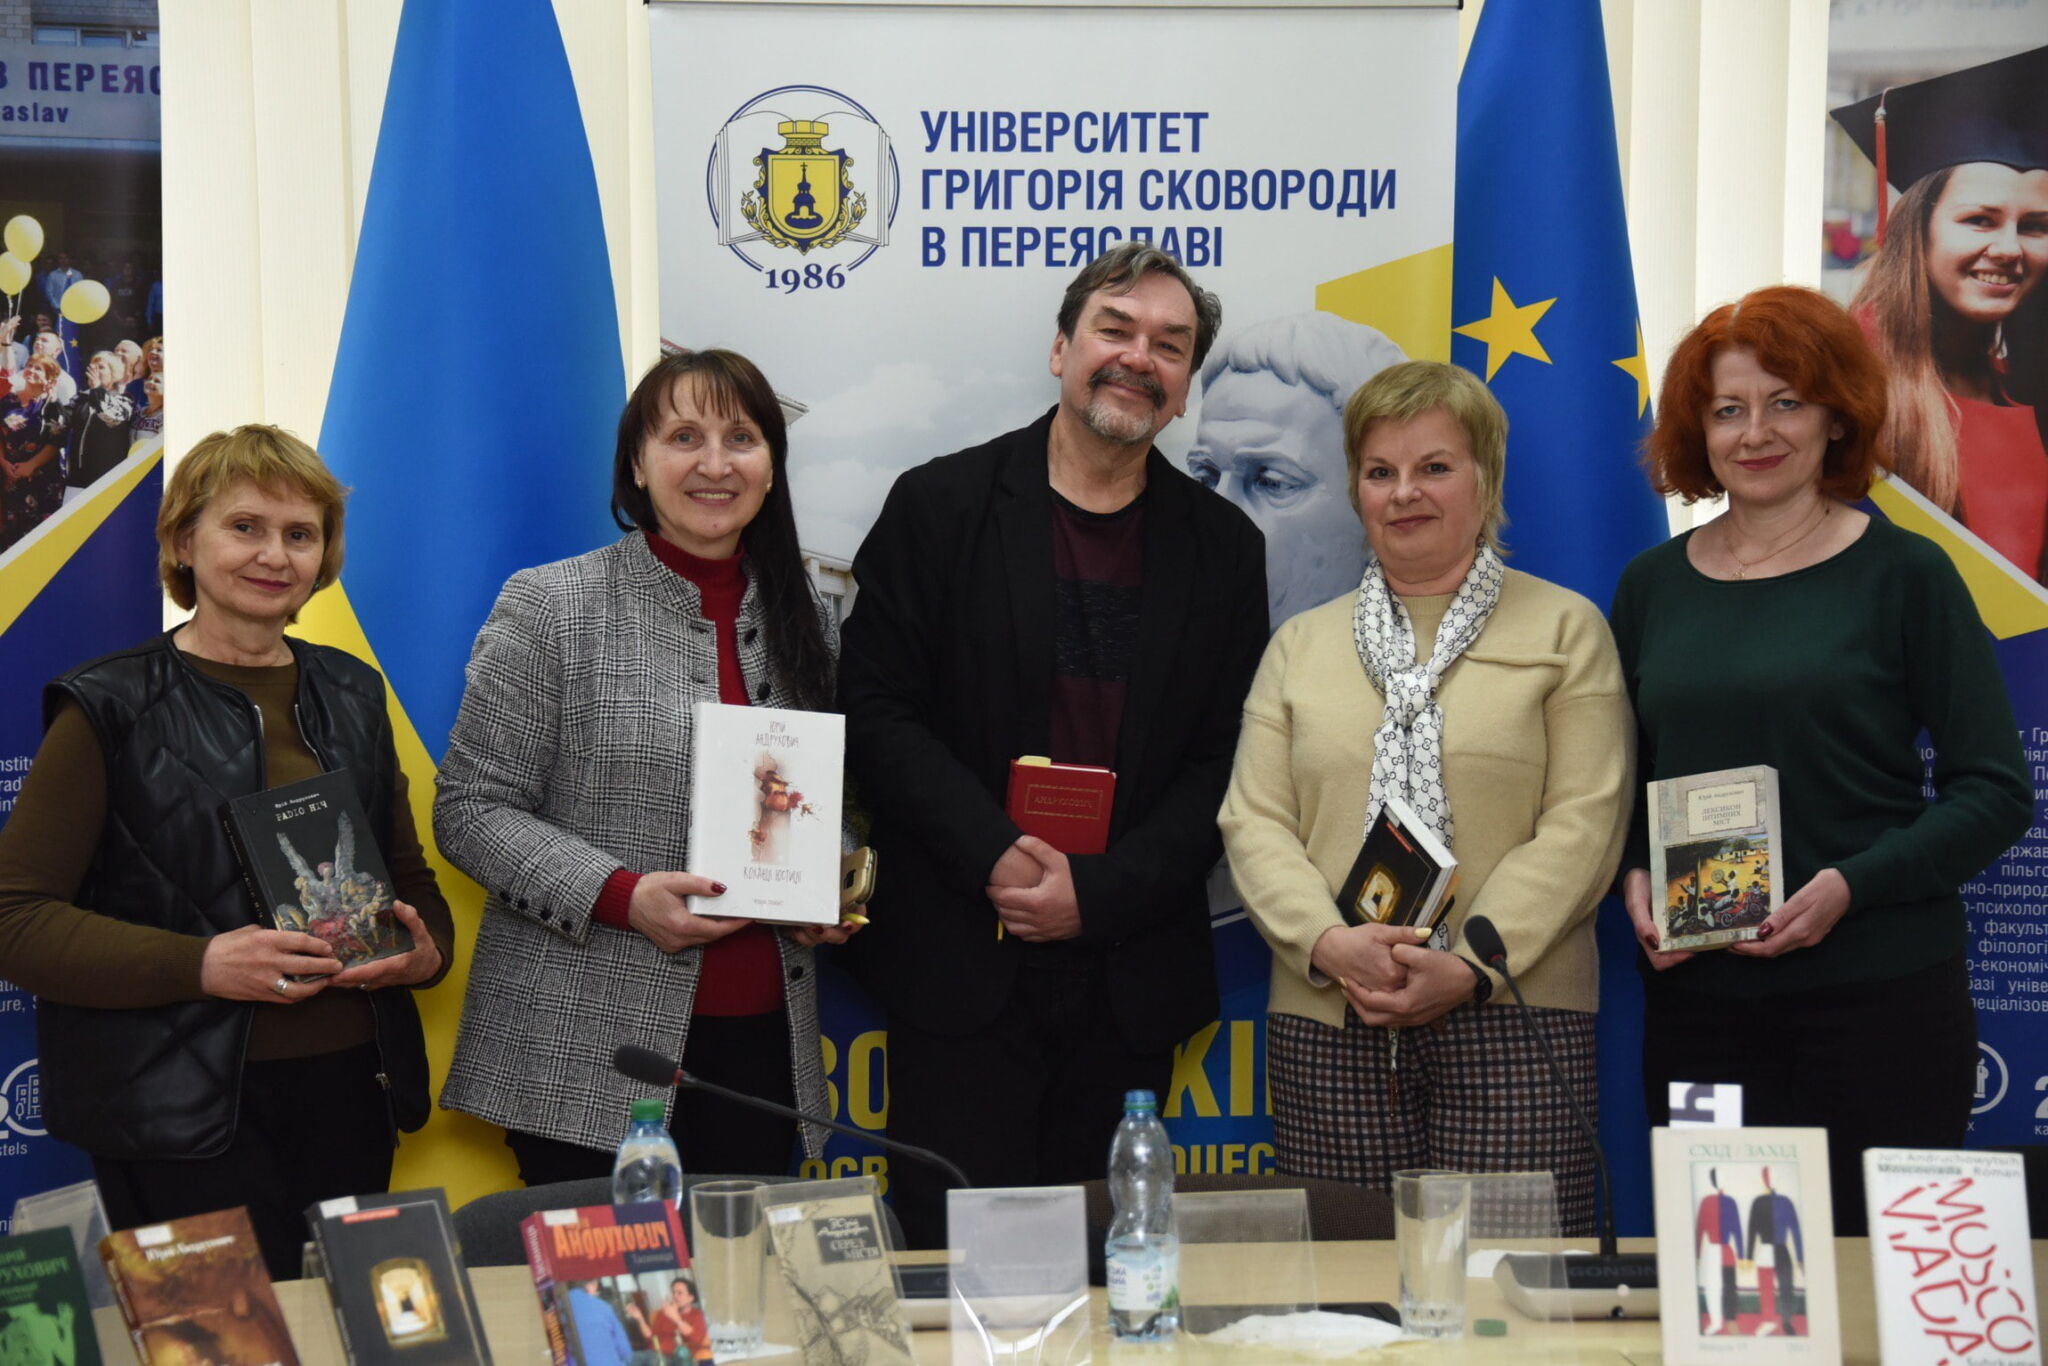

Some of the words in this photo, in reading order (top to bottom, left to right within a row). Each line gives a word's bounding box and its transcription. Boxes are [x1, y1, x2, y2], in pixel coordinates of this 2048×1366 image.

[920, 111, 1208, 154] УНІВЕРСИТЕТ
[920, 169, 1123, 211] ГРИГОРІЯ
[1139, 168, 1397, 218] СКОВОРОДИ
[921, 226, 946, 267] В
[764, 263, 847, 294] 1986
